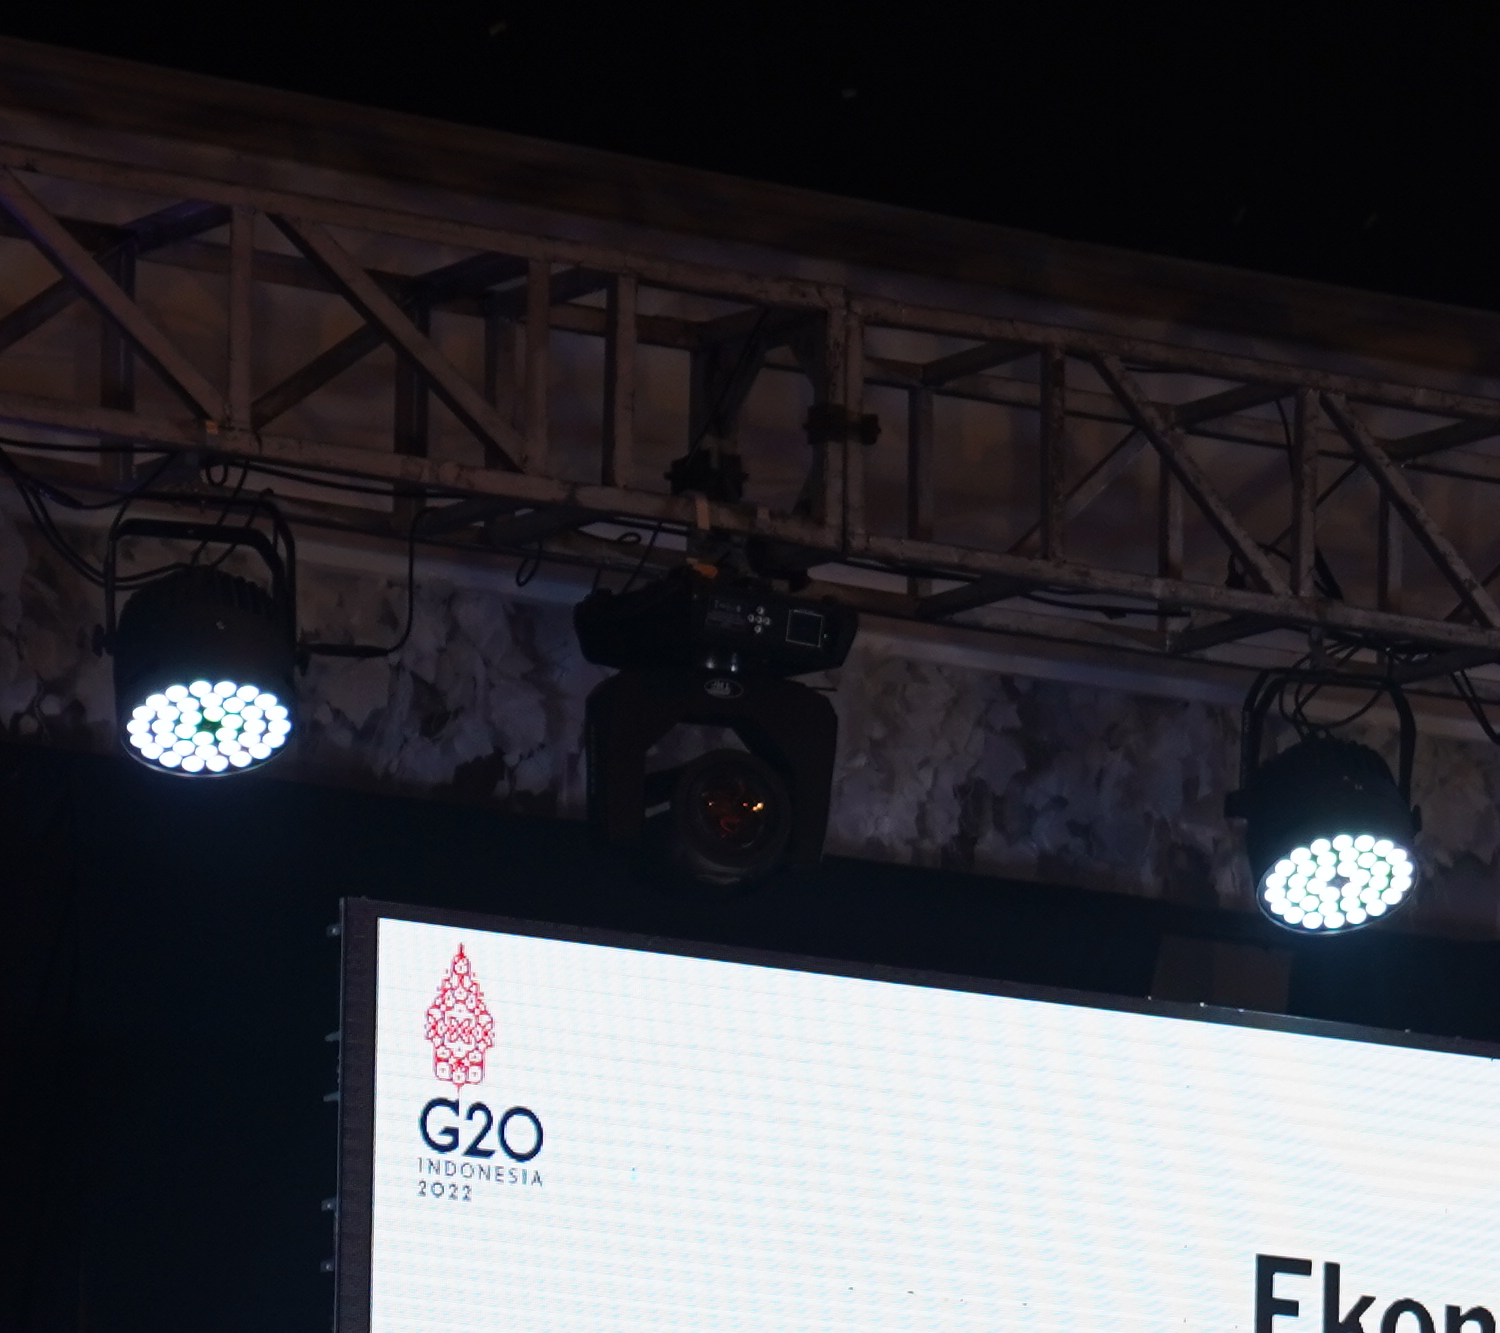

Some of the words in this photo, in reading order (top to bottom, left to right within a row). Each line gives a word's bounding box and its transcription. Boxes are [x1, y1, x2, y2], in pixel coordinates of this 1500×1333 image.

[419, 1097, 543, 1162] G20
[417, 1157, 543, 1187] INDONESIA
[417, 1180, 473, 1202] 2022
